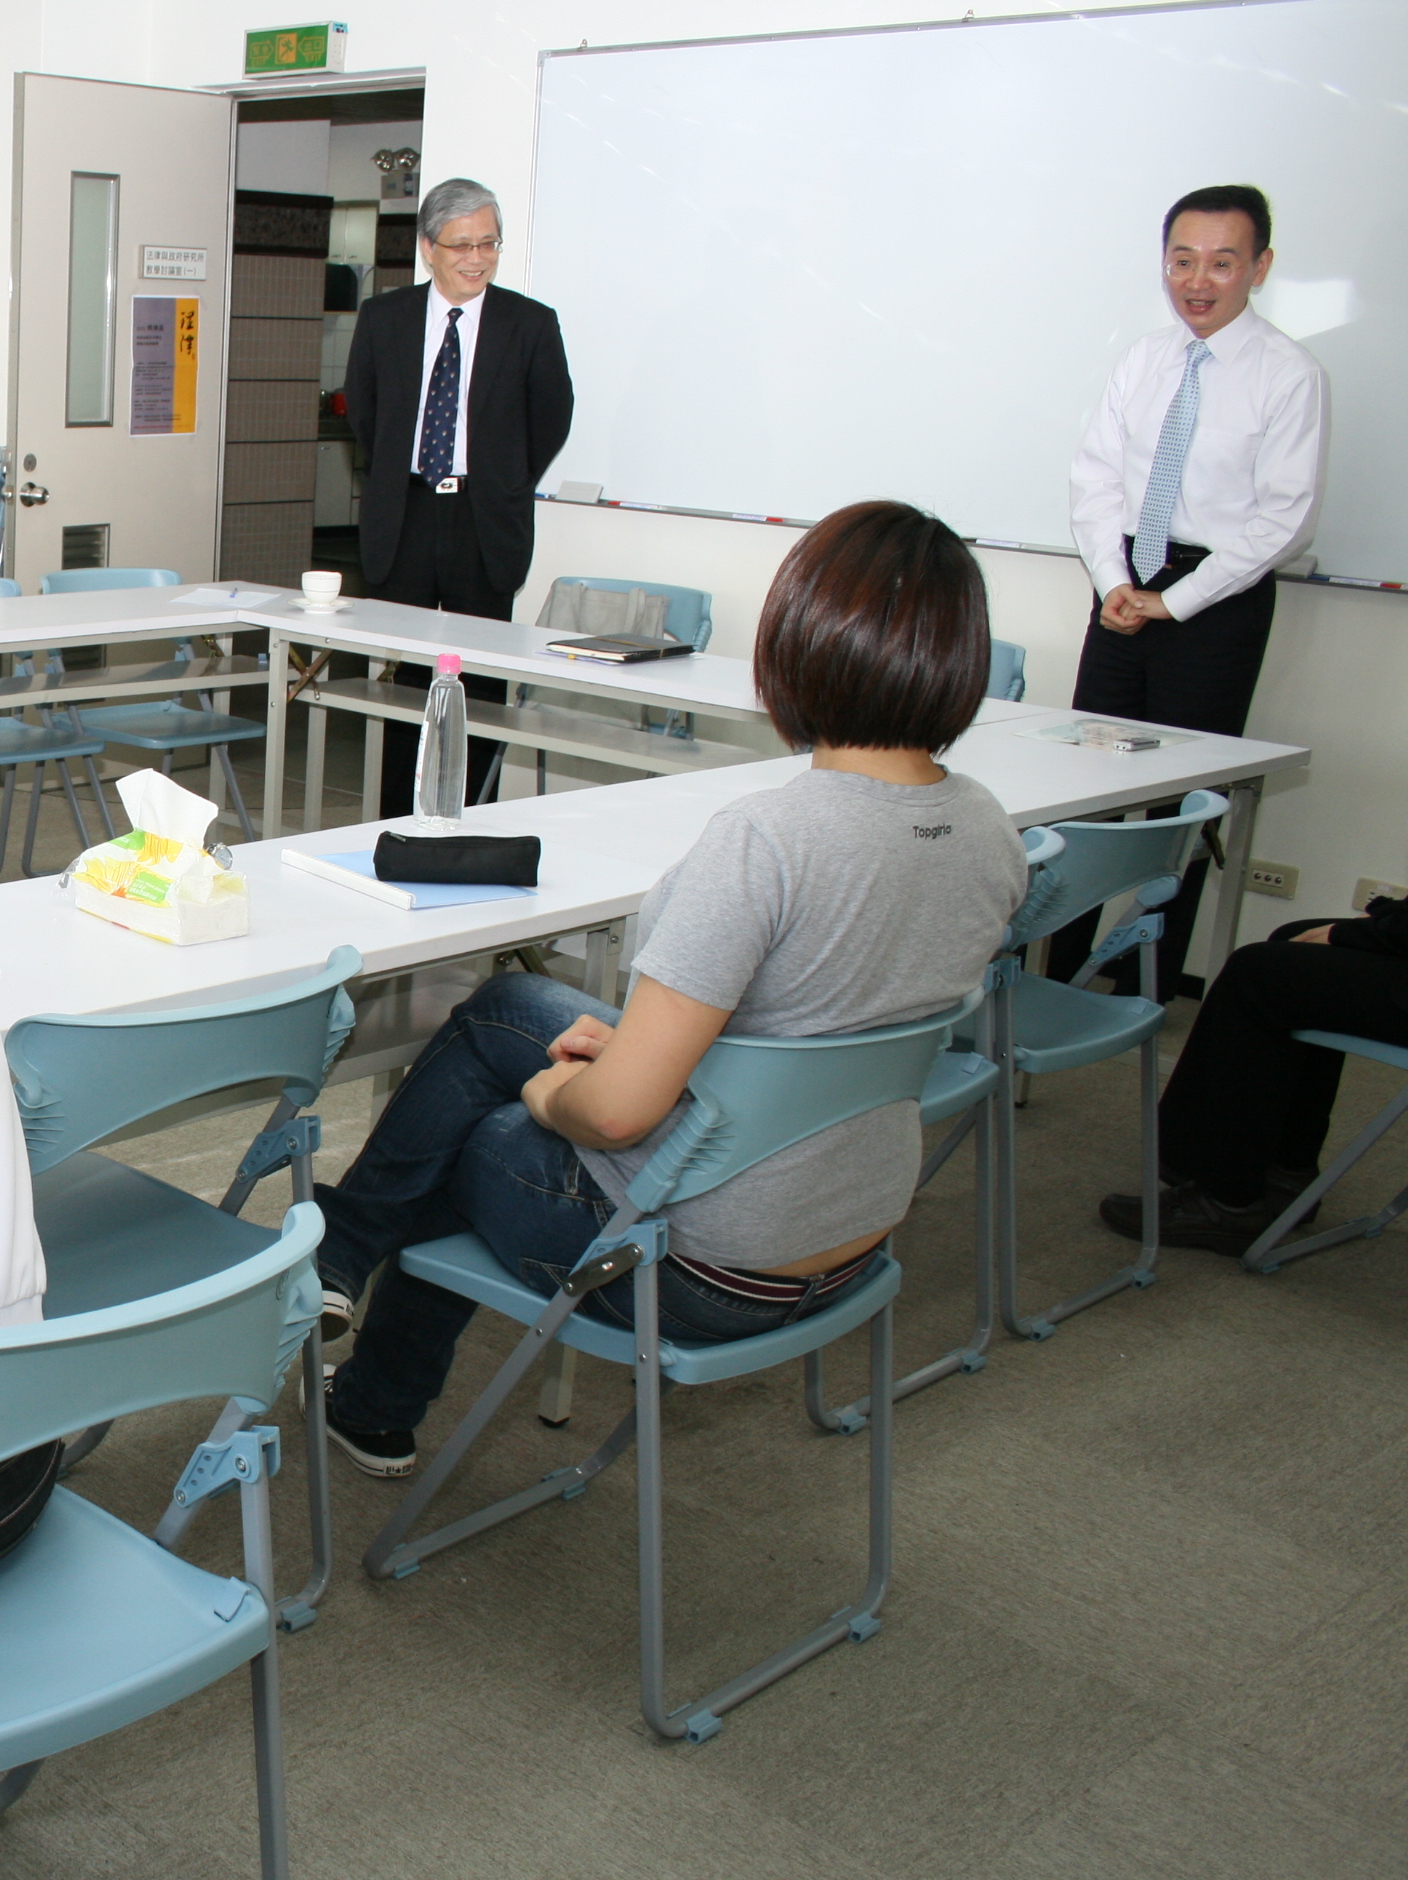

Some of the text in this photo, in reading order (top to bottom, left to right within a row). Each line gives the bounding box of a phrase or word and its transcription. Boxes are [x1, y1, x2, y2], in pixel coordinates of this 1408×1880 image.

[146, 250, 204, 262] 法律與政府研究所
